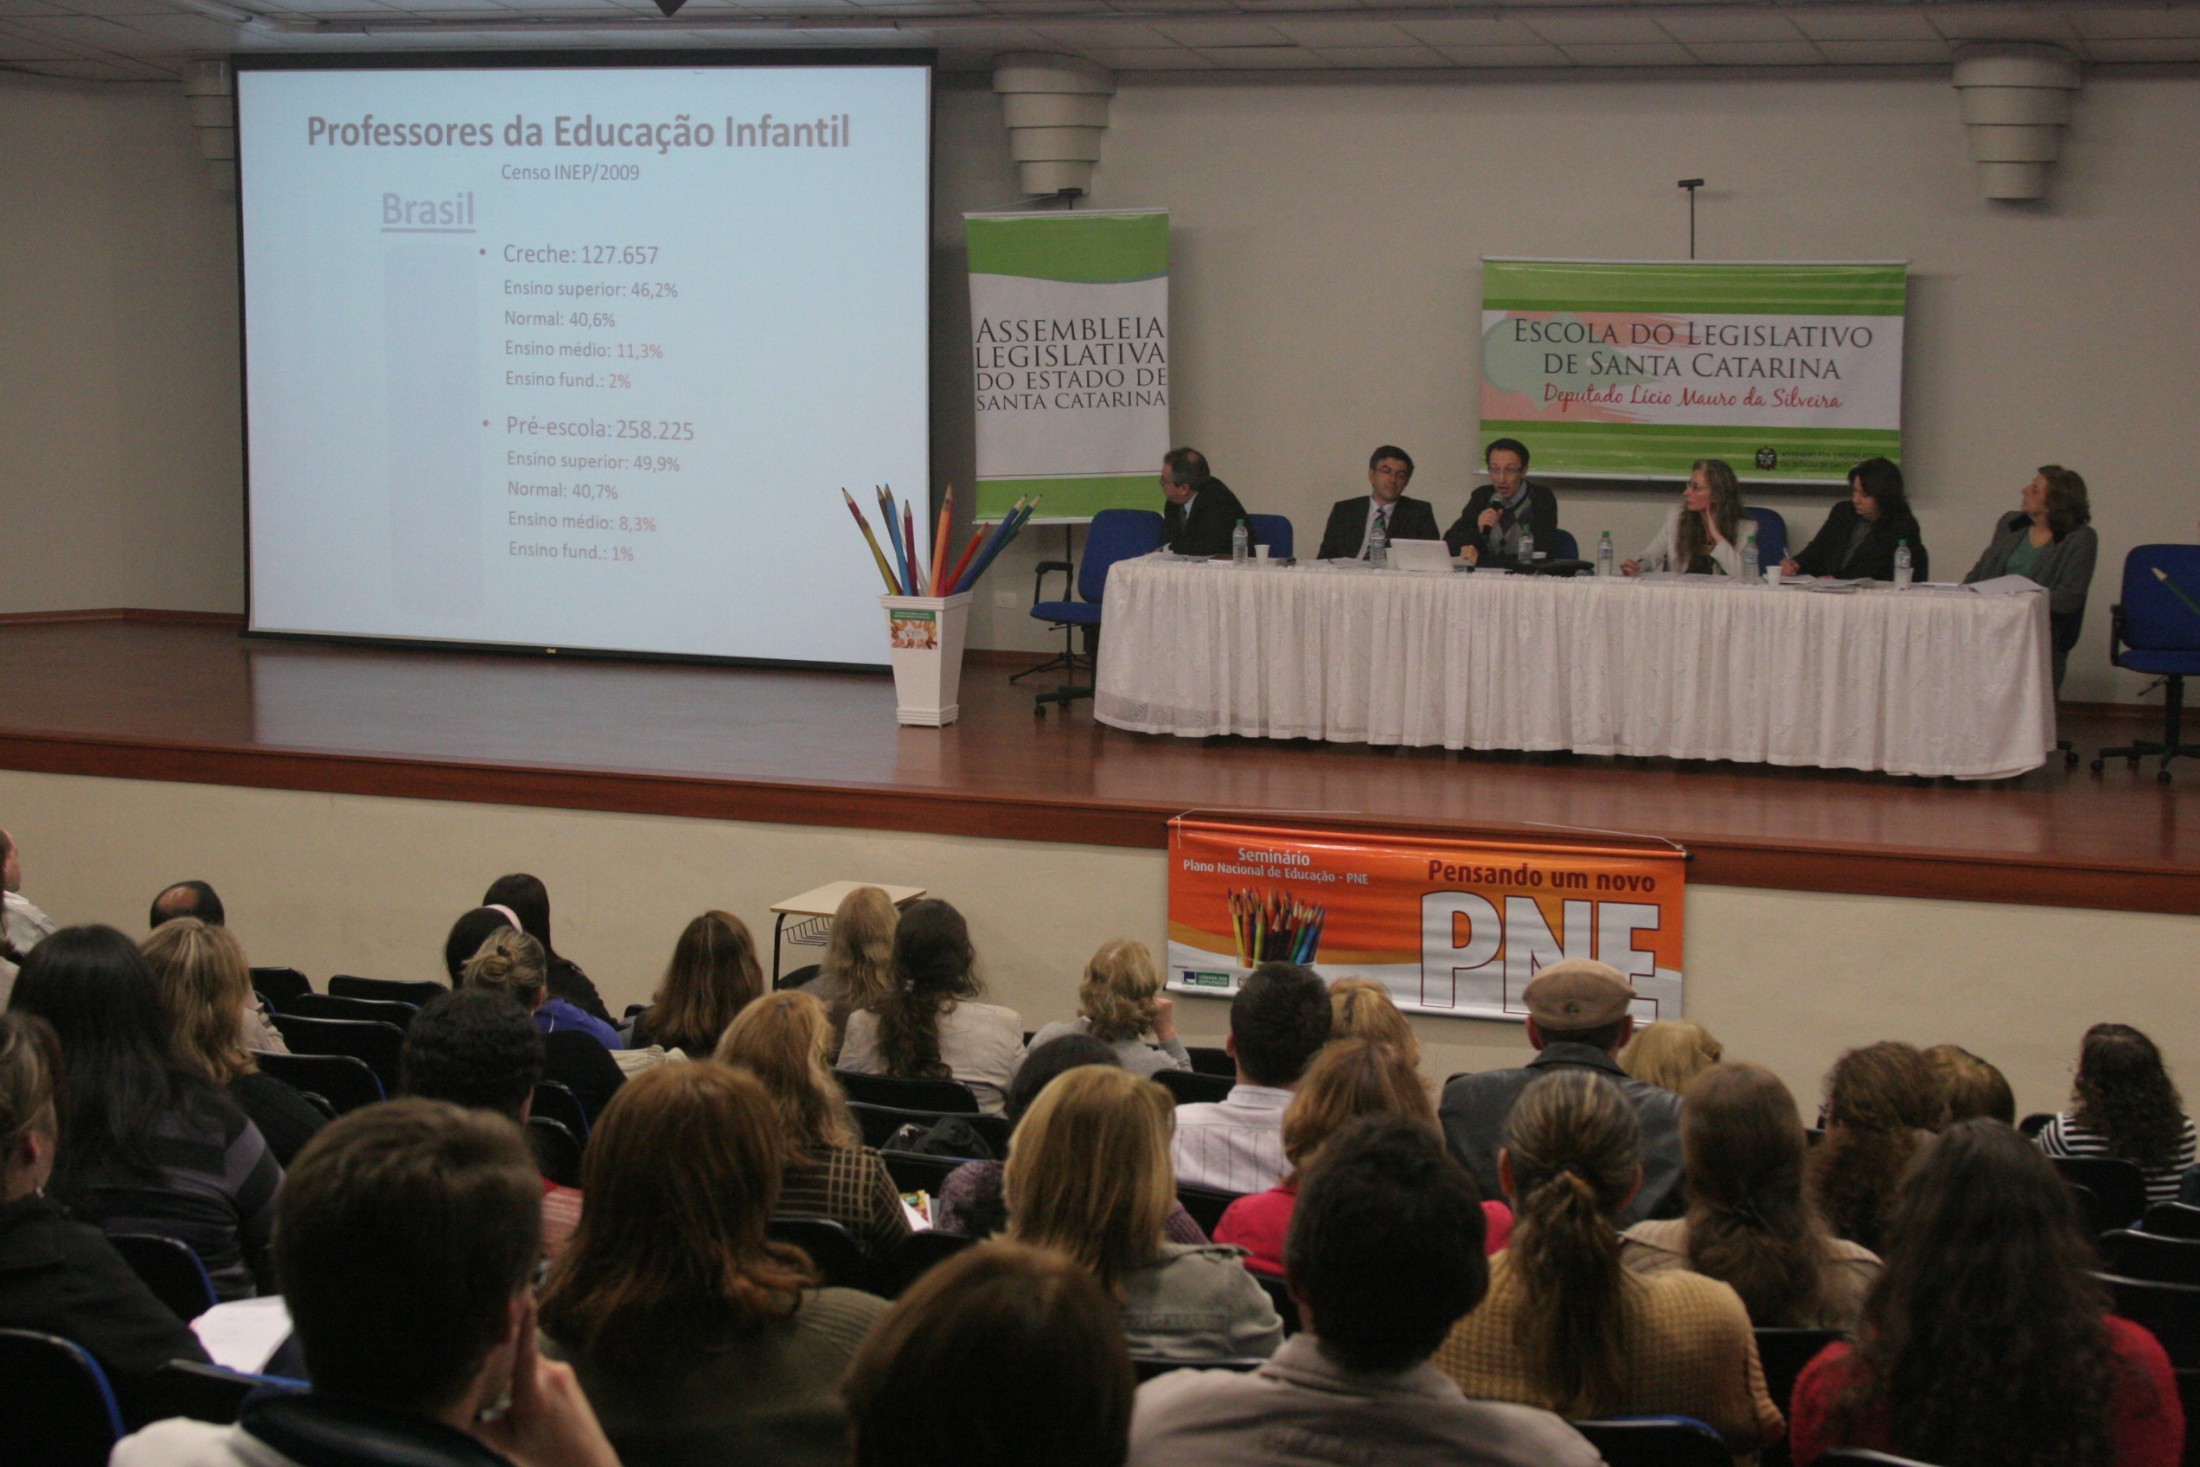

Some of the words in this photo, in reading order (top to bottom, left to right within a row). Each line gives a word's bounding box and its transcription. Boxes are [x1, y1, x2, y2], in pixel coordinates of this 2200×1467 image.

[307, 114, 494, 147] Professores
[503, 114, 543, 147] da
[554, 113, 715, 155] Educação
[725, 113, 850, 148] Infantil
[501, 164, 551, 181] Censo
[554, 163, 640, 183] INEP/2009
[381, 191, 475, 226] Brasil
[503, 244, 577, 264] Creche:
[581, 245, 659, 266] 127.657
[504, 280, 554, 296] Ensino
[557, 281, 627, 300] superior:
[631, 282, 678, 300] 46,2%
[504, 310, 565, 327] Normal:
[569, 312, 616, 329] 40,6%
[976, 316, 1165, 343] ASSEMBLEIA
[1515, 318, 1618, 344] ESCOLA
[1631, 323, 1674, 345] DO
[1687, 321, 1873, 348] LEGISLATIVO
[505, 340, 555, 357] Ensino
[558, 341, 612, 358] médio:
[616, 343, 664, 361] 11,3%
[976, 341, 1166, 369] LEGISLATIVA
[1543, 353, 1578, 374] DE
[1590, 351, 1682, 376] SANTA
[1692, 353, 1842, 379] CATARINA
[505, 371, 556, 387] Ensino
[559, 372, 605, 388] fund.:
[608, 374, 632, 389] 2%
[977, 372, 1014, 391] DO
[1026, 369, 1125, 390] ESTADO
[1136, 367, 1167, 387] DE
[977, 393, 1048, 412] SANTA
[1054, 390, 1167, 409] CATARINA
[1543, 382, 1623, 413] Deputado
[1630, 384, 1672, 406] Lício
[1677, 387, 1737, 407] Mauro
[1743, 386, 1767, 407] da
[1772, 386, 1843, 409] Silveira
[506, 416, 613, 438] Pré-escola:
[616, 419, 695, 441] 258.225
[507, 450, 557, 468] Ensino
[561, 453, 629, 471] superior:
[633, 455, 681, 473] 49,9%
[507, 480, 568, 498] Normal:
[572, 483, 619, 501] 40,7%
[508, 511, 558, 528] Ensino
[562, 513, 615, 531] médio:
[619, 516, 657, 533] 8,3%
[508, 541, 559, 559] Ensino
[562, 543, 607, 561] fund.:
[611, 546, 634, 562] 1%
[1238, 847, 1311, 867] Seminário
[1183, 859, 1214, 873] Plano
[1217, 861, 1264, 877] Nacional
[1267, 865, 1281, 878] de
[1284, 868, 1335, 884] Educação
[1346, 872, 1369, 885] PNE
[1428, 859, 1543, 887] Pensando
[1551, 870, 1588, 889] um
[1596, 873, 1656, 893] novo
[1420, 890, 1660, 1024] PNE
